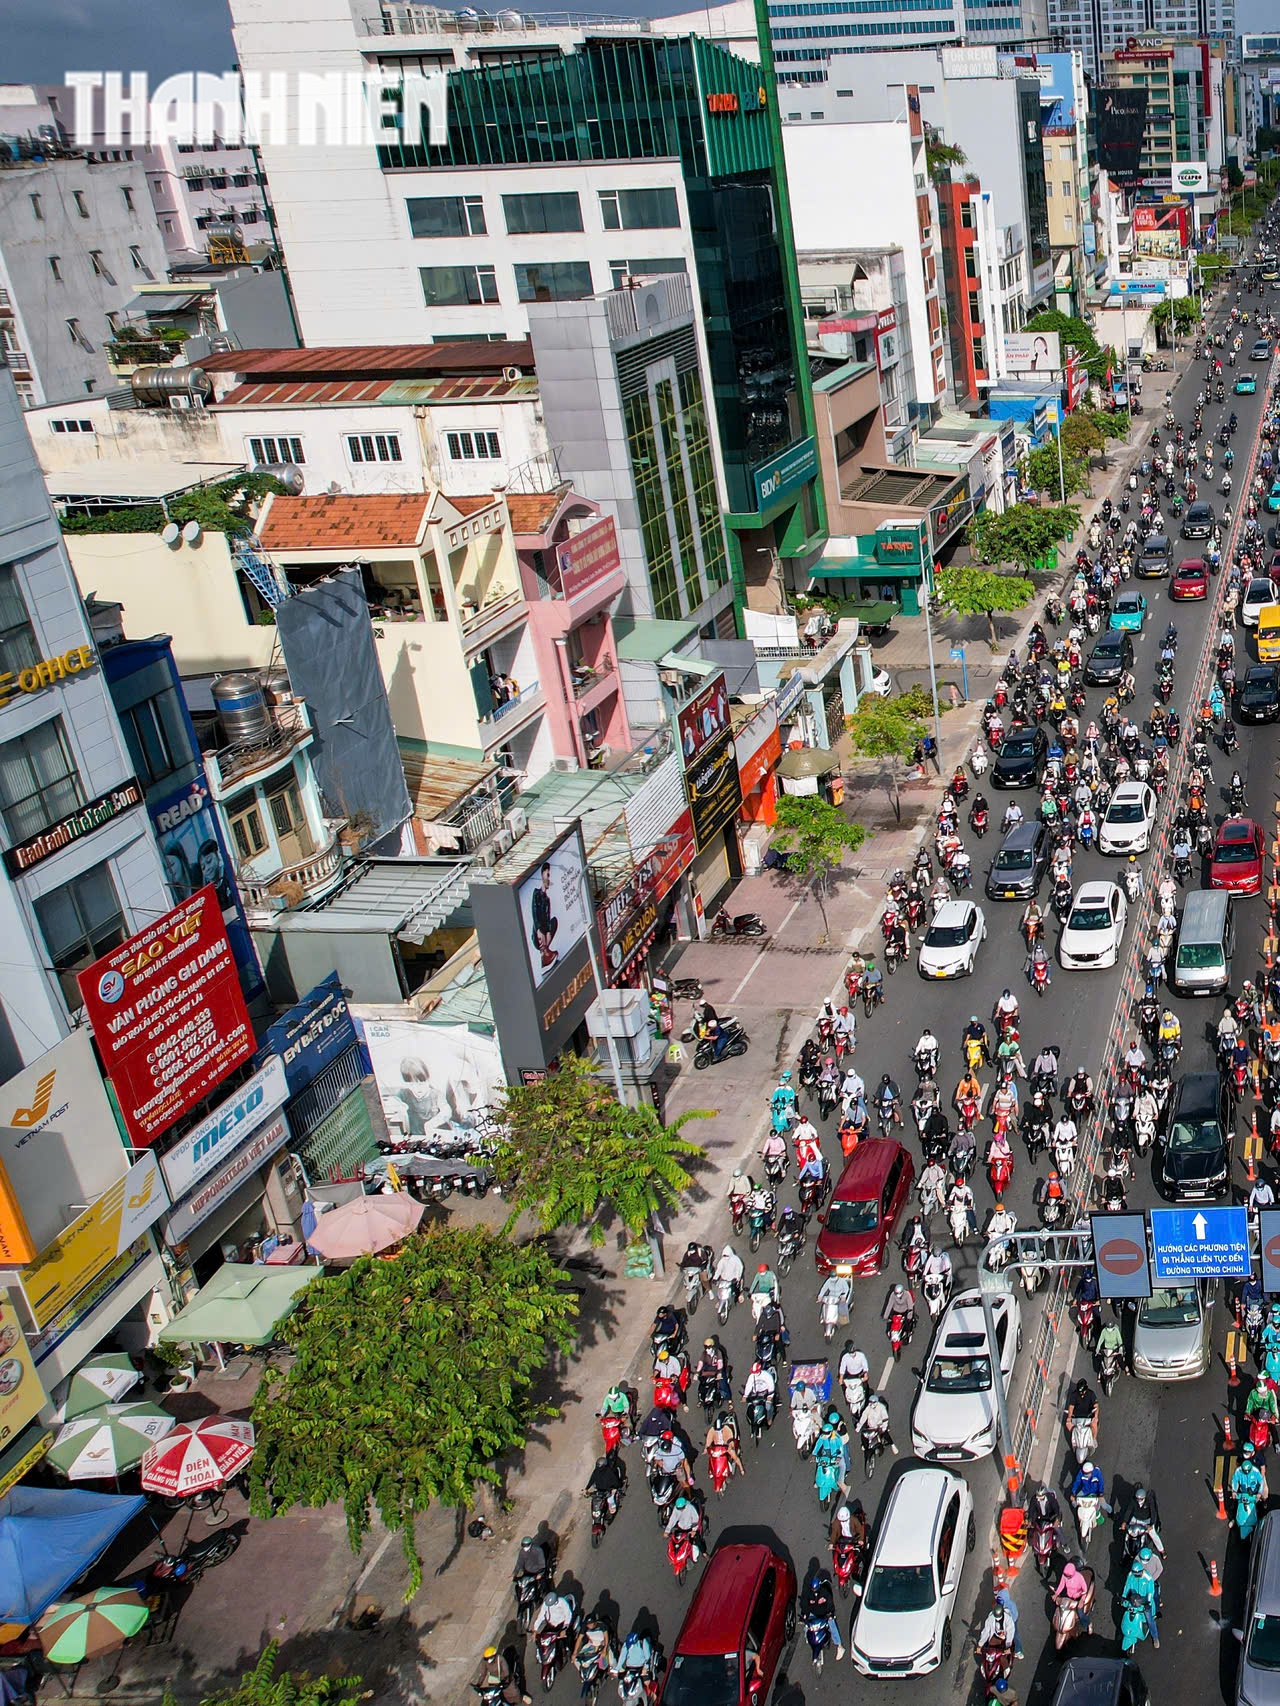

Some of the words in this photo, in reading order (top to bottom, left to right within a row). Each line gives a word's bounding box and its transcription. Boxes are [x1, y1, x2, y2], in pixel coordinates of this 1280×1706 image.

[1138, 38, 1163, 47] VNO
[761, 474, 776, 499] BIDV
[18, 644, 94, 693] OFFICE
[157, 793, 204, 833] READ
[109, 949, 129, 967] TRUNG
[122, 939, 164, 978] SAO
[165, 908, 205, 949] VIỆT
[106, 1004, 134, 1036] VĂN
[135, 973, 176, 1013] PHÒNG
[178, 959, 197, 982] GHI
[198, 937, 226, 967] DANH
[156, 1009, 210, 1057] 0942.048.333
[299, 1016, 324, 1047] BIẾT
[321, 998, 346, 1029] ĐỌC
[159, 1020, 213, 1069] 0901.897.555
[163, 1031, 216, 1081] 0966.102.777
[14, 1119, 51, 1149] VIETNAM
[50, 1102, 70, 1122] POST
[190, 1122, 209, 1144] CÔNG
[210, 1115, 219, 1126] TY
[220, 1099, 237, 1117] TNHH
[238, 1076, 263, 1100] THƯƠNG
[193, 1085, 264, 1164] MESO
[191, 1156, 247, 1214] NIPPONHITECH
[247, 1136, 266, 1163] VIỆT
[265, 1121, 282, 1145] NAM
[60, 1229, 76, 1248] VIỆT
[76, 1215, 93, 1234] NAM
[1158, 1243, 1183, 1253] HƯỚNG
[1184, 1243, 1198, 1252] CÁC
[1200, 1243, 1228, 1252] PHƯƠNG
[1230, 1243, 1246, 1252] TIỆN
[1162, 1256, 1170, 1264] ĐI
[1171, 1253, 1195, 1263] THẲNG
[1196, 1254, 1213, 1263] LIÊN
[1214, 1255, 1228, 1264] TỤC
[1228, 1253, 1244, 1262] ĐẾN
[1166, 1266, 1191, 1275] ĐƯỜNG
[1192, 1265, 1221, 1274] TRƯỜNG
[186, 1458, 211, 1474] ĐIỆN
[234, 1444, 250, 1459] VIÊN
[184, 1469, 216, 1486] THOẠI
